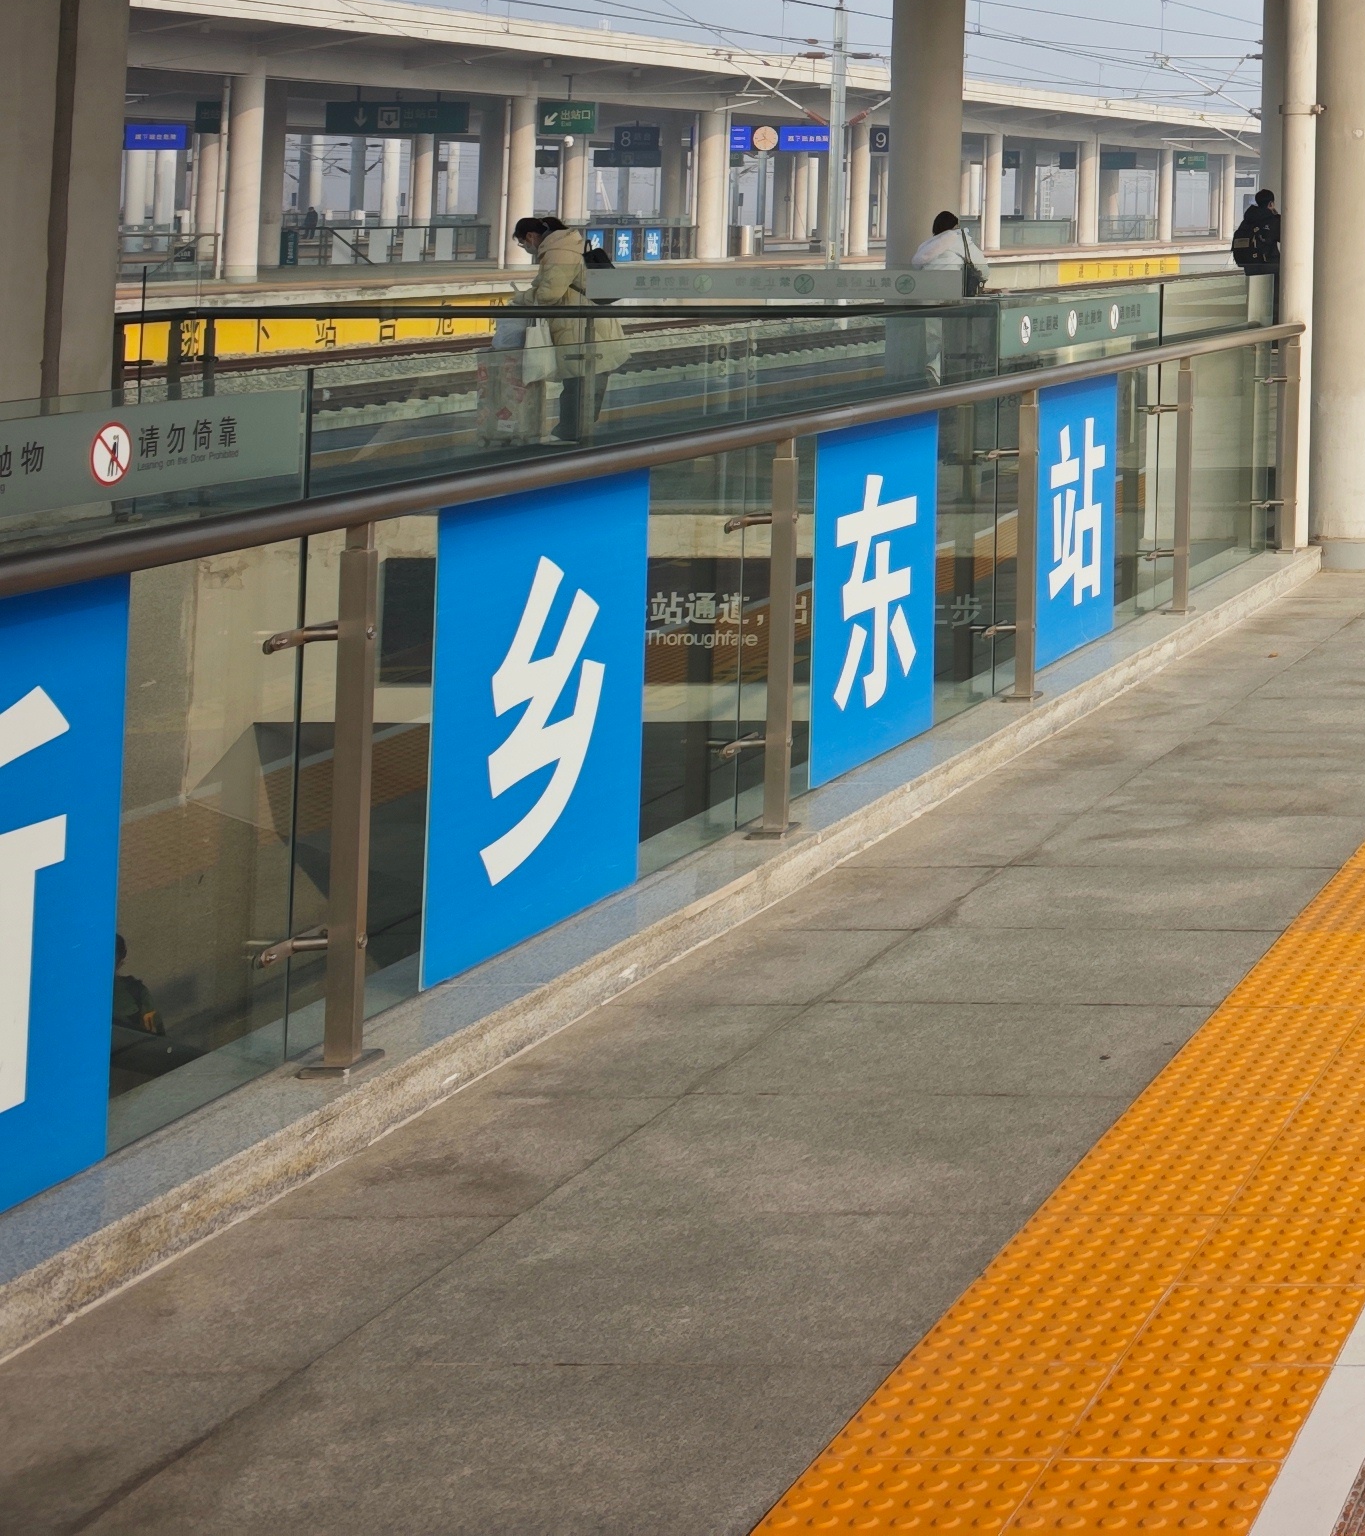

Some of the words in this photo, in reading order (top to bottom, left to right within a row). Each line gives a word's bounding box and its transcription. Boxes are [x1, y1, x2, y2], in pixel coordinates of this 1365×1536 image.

[560, 109, 591, 120] 出站口
[620, 130, 631, 147] 8
[875, 132, 887, 148] 9
[138, 416, 237, 458] 请勿倚靠
[166, 458, 175, 467] on
[190, 453, 206, 463] Door
